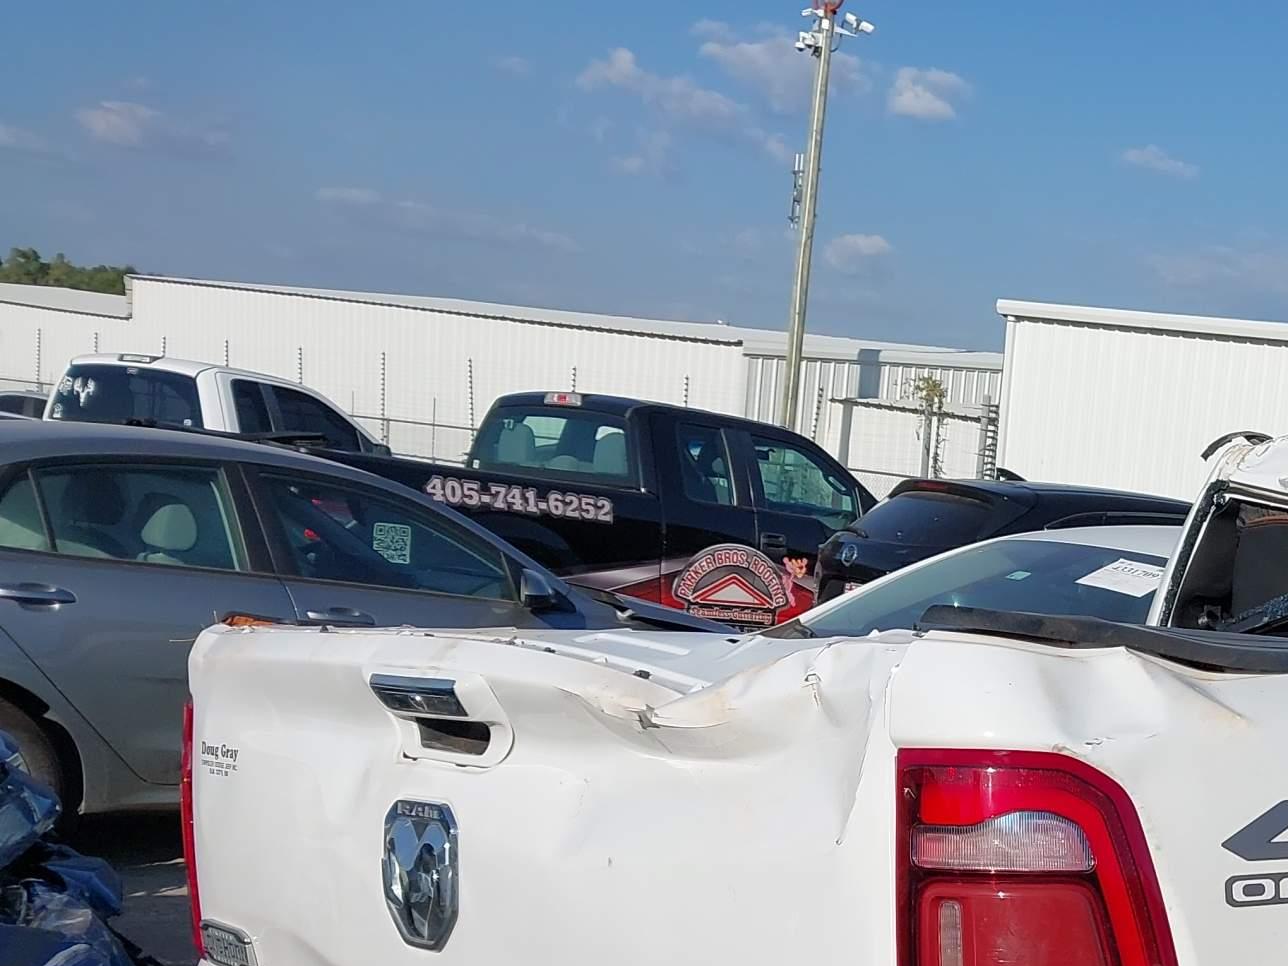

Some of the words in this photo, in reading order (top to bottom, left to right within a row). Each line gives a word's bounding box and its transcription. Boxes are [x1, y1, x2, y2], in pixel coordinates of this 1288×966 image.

[426, 475, 613, 523] 405-741-6252
[677, 554, 715, 599] PARKER
[714, 549, 750, 568] BROS.
[748, 555, 786, 607] ROOFING
[201, 740, 219, 760] Doug
[220, 744, 239, 762] Gray
[396, 800, 444, 820] RAM
